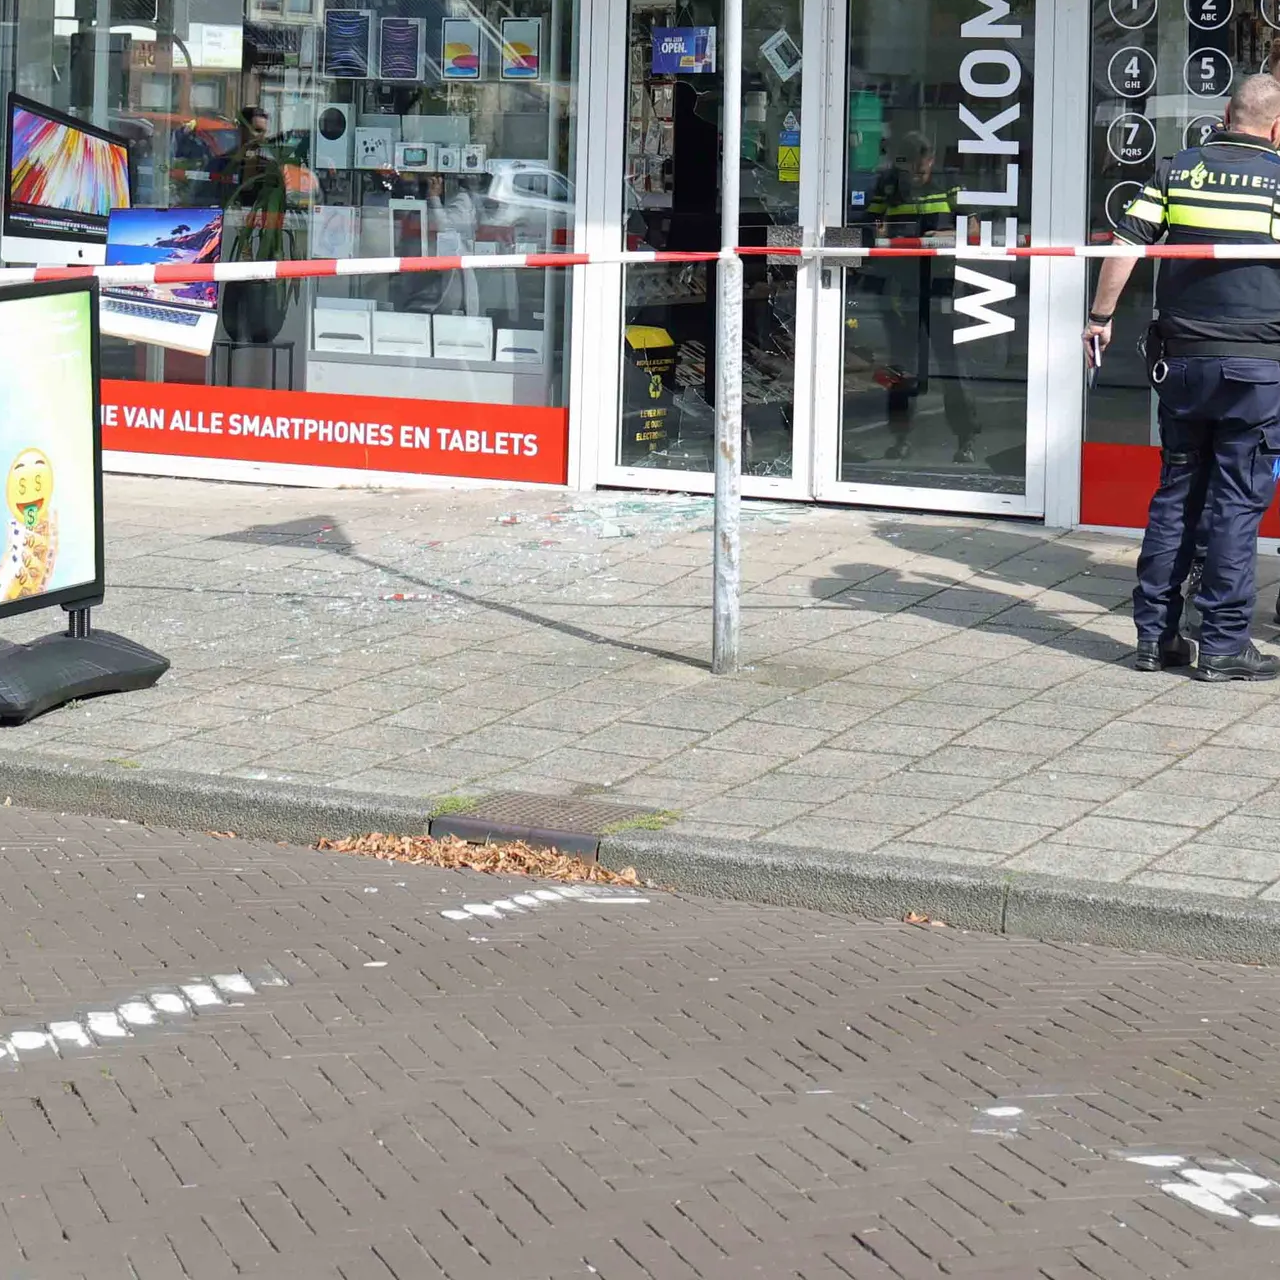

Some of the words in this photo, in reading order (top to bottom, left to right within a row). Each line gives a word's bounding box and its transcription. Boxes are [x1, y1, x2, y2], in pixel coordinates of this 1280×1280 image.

[1200, 13, 1217, 21] ABC
[661, 42, 688, 54] OPEN.
[1124, 56, 1140, 78] 4
[1200, 57, 1215, 80] 5
[1124, 80, 1141, 89] GHI
[1200, 82, 1216, 91] JKL
[1124, 123, 1139, 145] 7
[1121, 148, 1142, 156] PQRS
[1179, 162, 1263, 189] POLITIE
[101, 404, 118, 427] IE
[123, 405, 165, 430] VAN
[169, 410, 224, 435] ALLE
[228, 412, 394, 448] SMARTPHONES
[400, 426, 431, 450] EN
[436, 427, 539, 457] TABLETS
